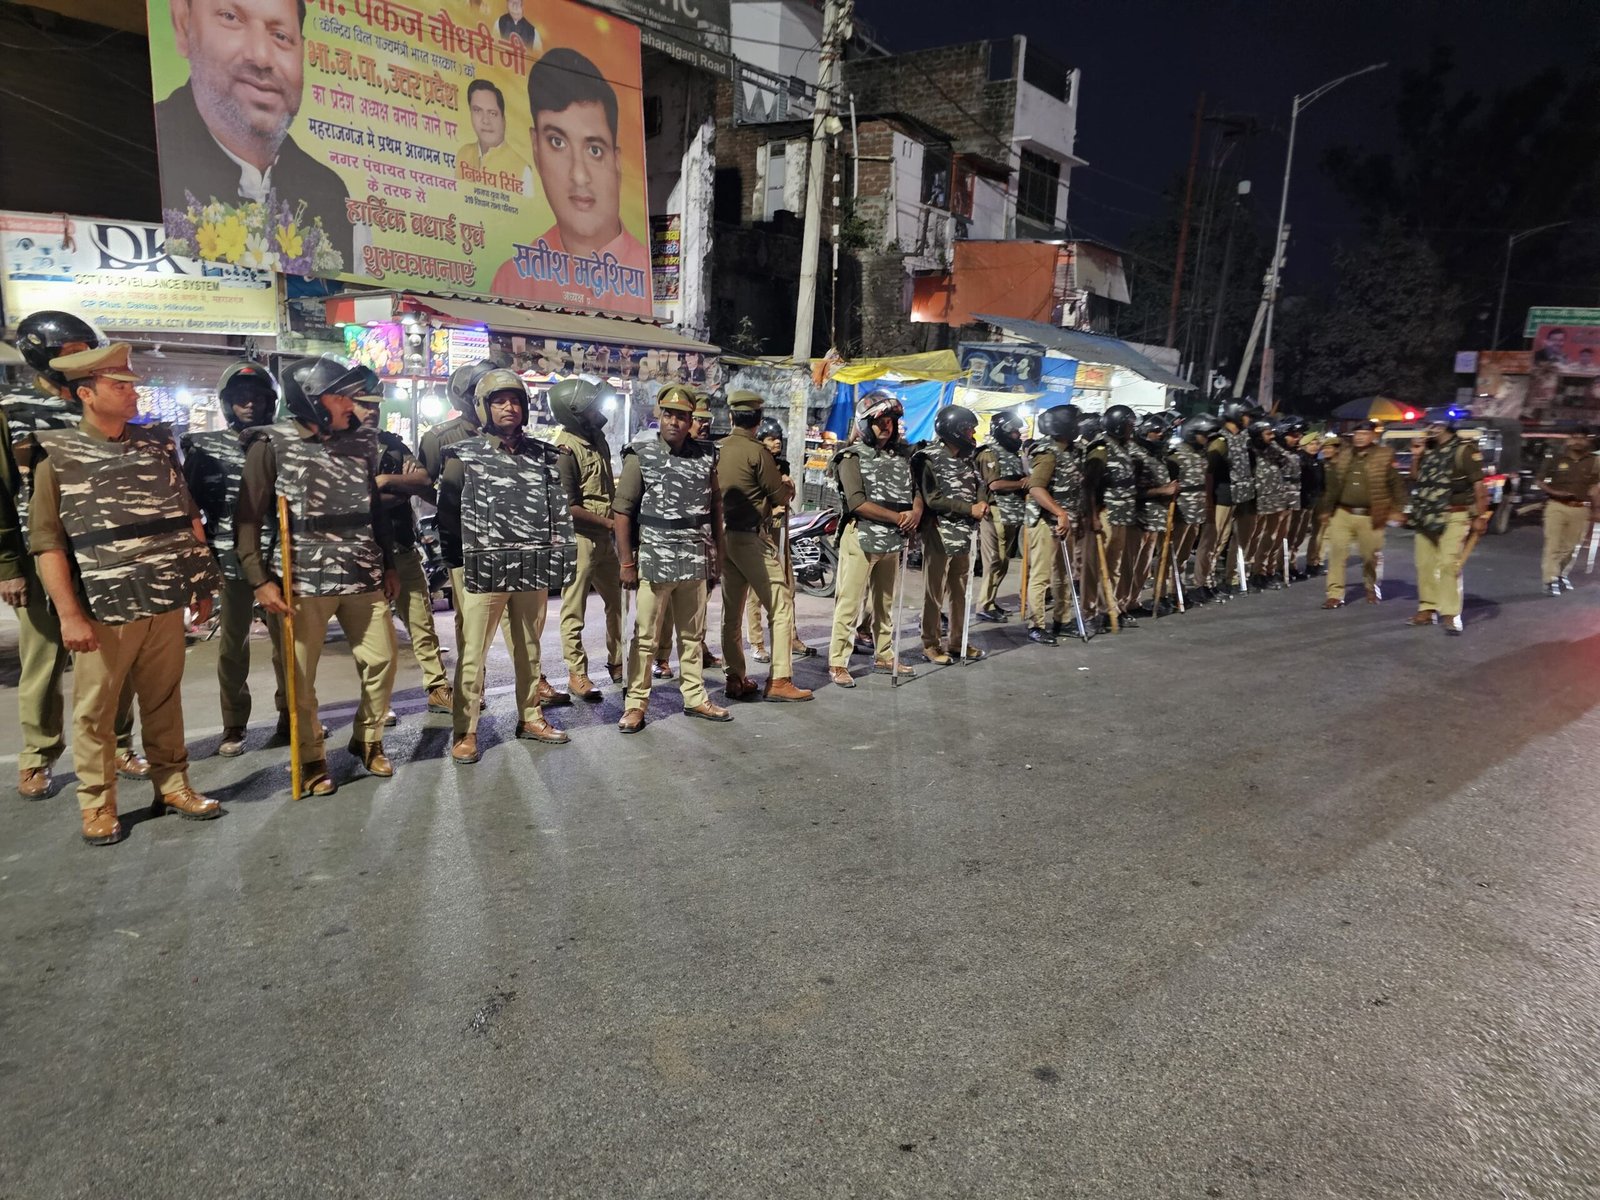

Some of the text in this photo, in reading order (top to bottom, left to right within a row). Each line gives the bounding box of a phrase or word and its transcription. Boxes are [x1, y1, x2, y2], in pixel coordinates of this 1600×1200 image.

[353, 0, 527, 76] पकज चौधरी जी
[411, 48, 429, 64] भारत
[642, 32, 726, 74] aharajganj Road
[312, 83, 459, 142] का प्रदेश अध्यक्ष बनाये जाने पर
[308, 117, 364, 147] महराजगंज
[378, 137, 402, 156] प्रथम
[405, 141, 441, 165] आगमन
[443, 151, 456, 169] पर
[329, 151, 458, 192] नगर पंचायत परतावल
[367, 176, 427, 203] के तरफ से
[461, 161, 524, 195] निर्भय सिंह
[345, 195, 485, 256] हार्दिक बधाई एवं
[94, 223, 189, 276] DK
[363, 245, 477, 287] शुभकामनाएं
[512, 238, 569, 287] सतीश
[74, 273, 102, 286] CCTV
[182, 280, 220, 292] SYSTEM
[81, 299, 96, 308] CP
